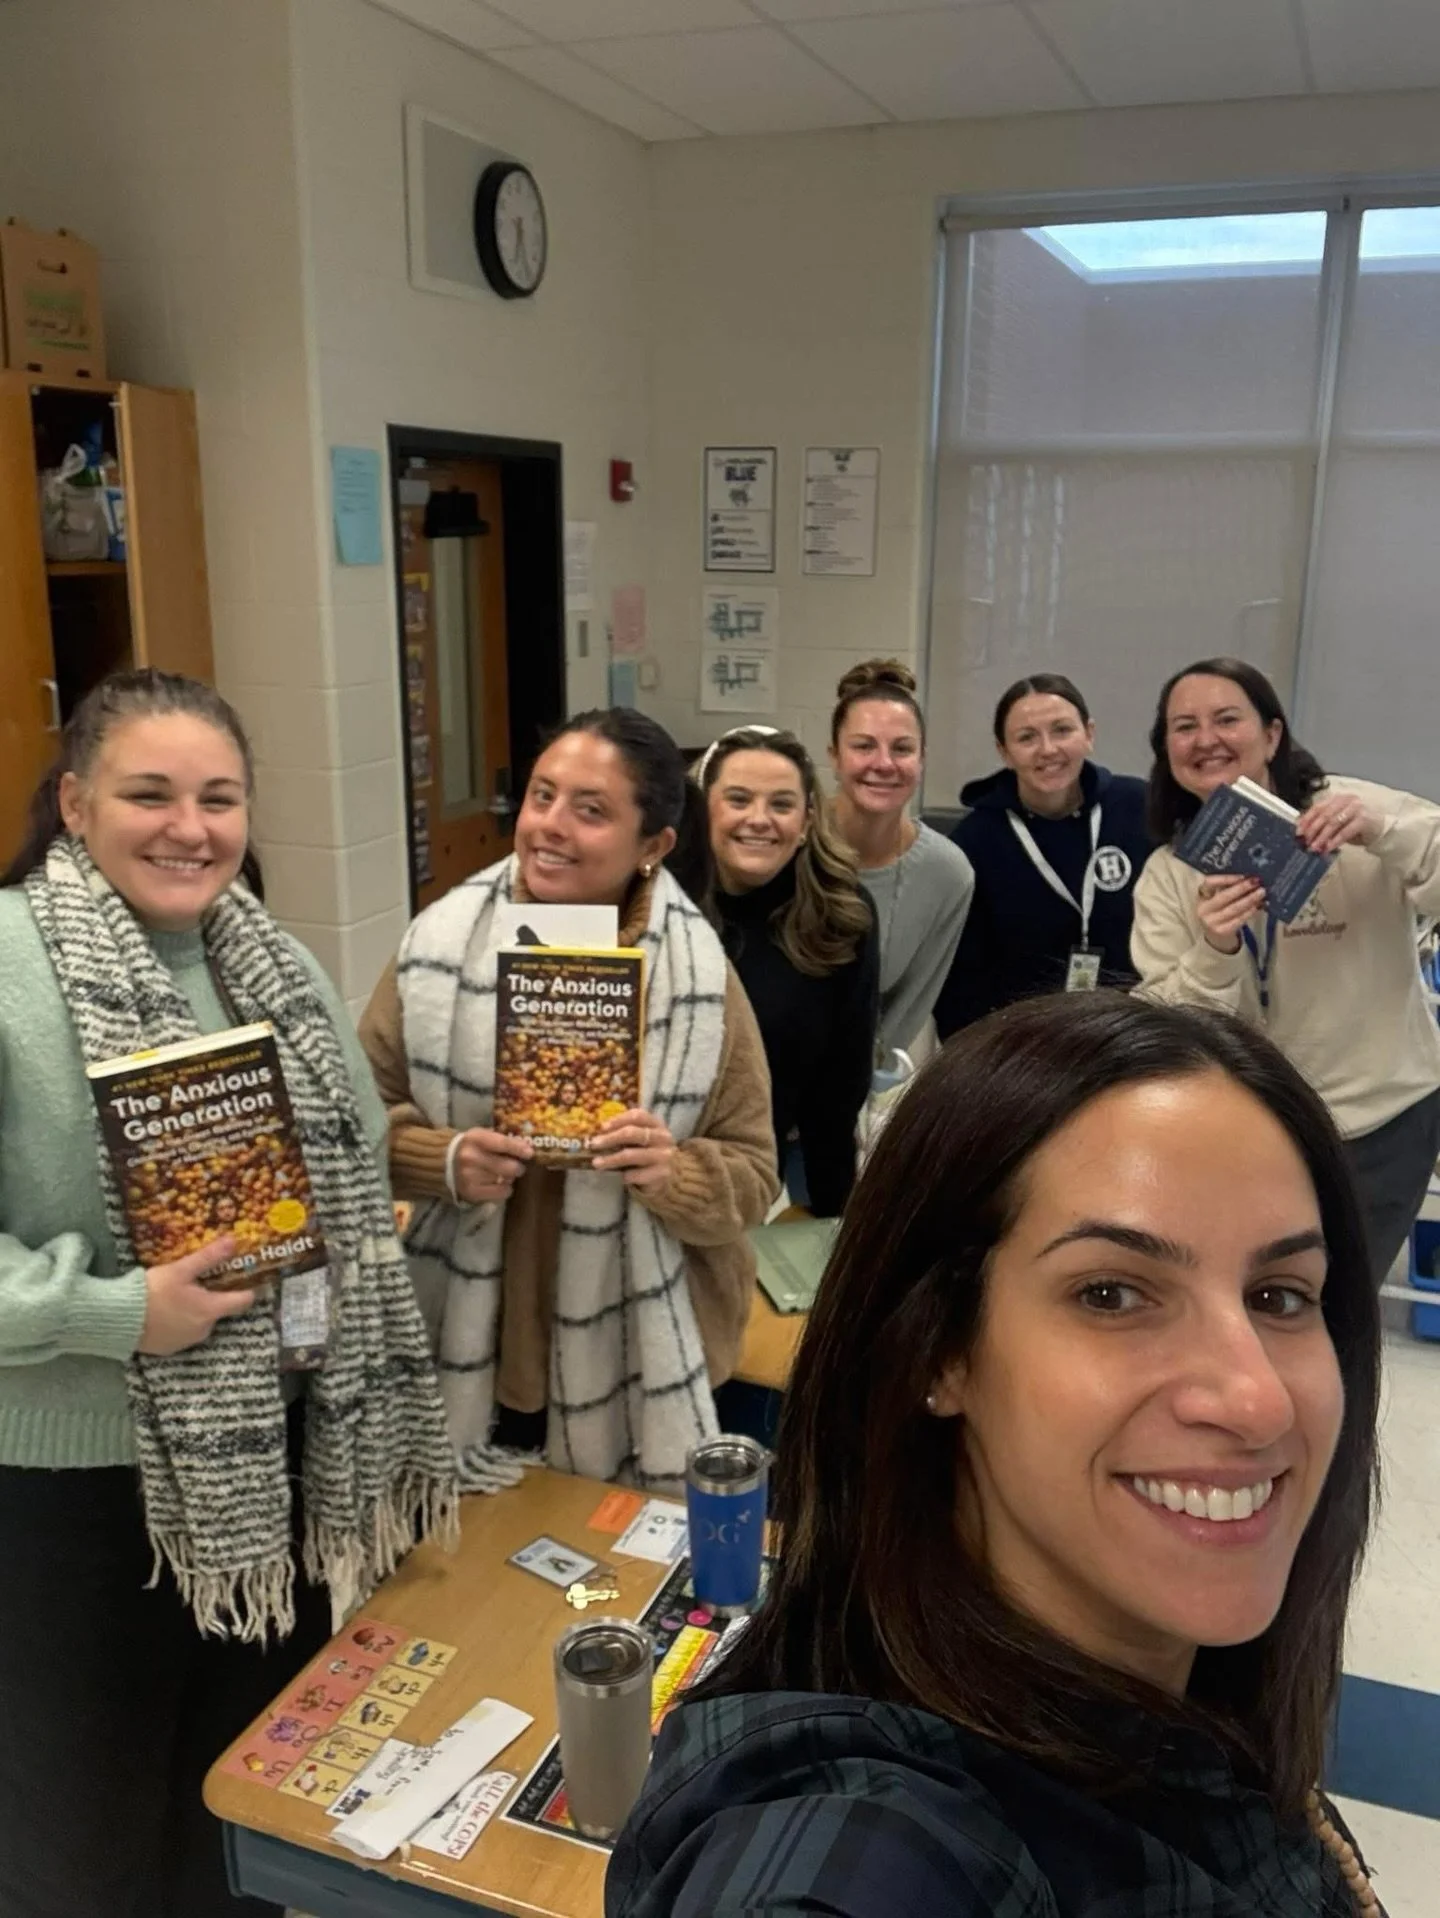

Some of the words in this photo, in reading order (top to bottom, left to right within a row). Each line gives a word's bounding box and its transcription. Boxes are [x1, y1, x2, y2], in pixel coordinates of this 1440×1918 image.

[1200, 845, 1221, 866] The
[1214, 804, 1250, 847] Anxious
[1213, 813, 1259, 871] Generation
[1098, 854, 1122, 882] H
[506, 973, 546, 993] The
[549, 976, 633, 997] Anxious
[509, 995, 629, 1018] Generation
[109, 1094, 163, 1119] The
[170, 1065, 273, 1105] Anxious
[123, 1091, 275, 1141] Generation
[259, 1235, 315, 1261] Haidt
